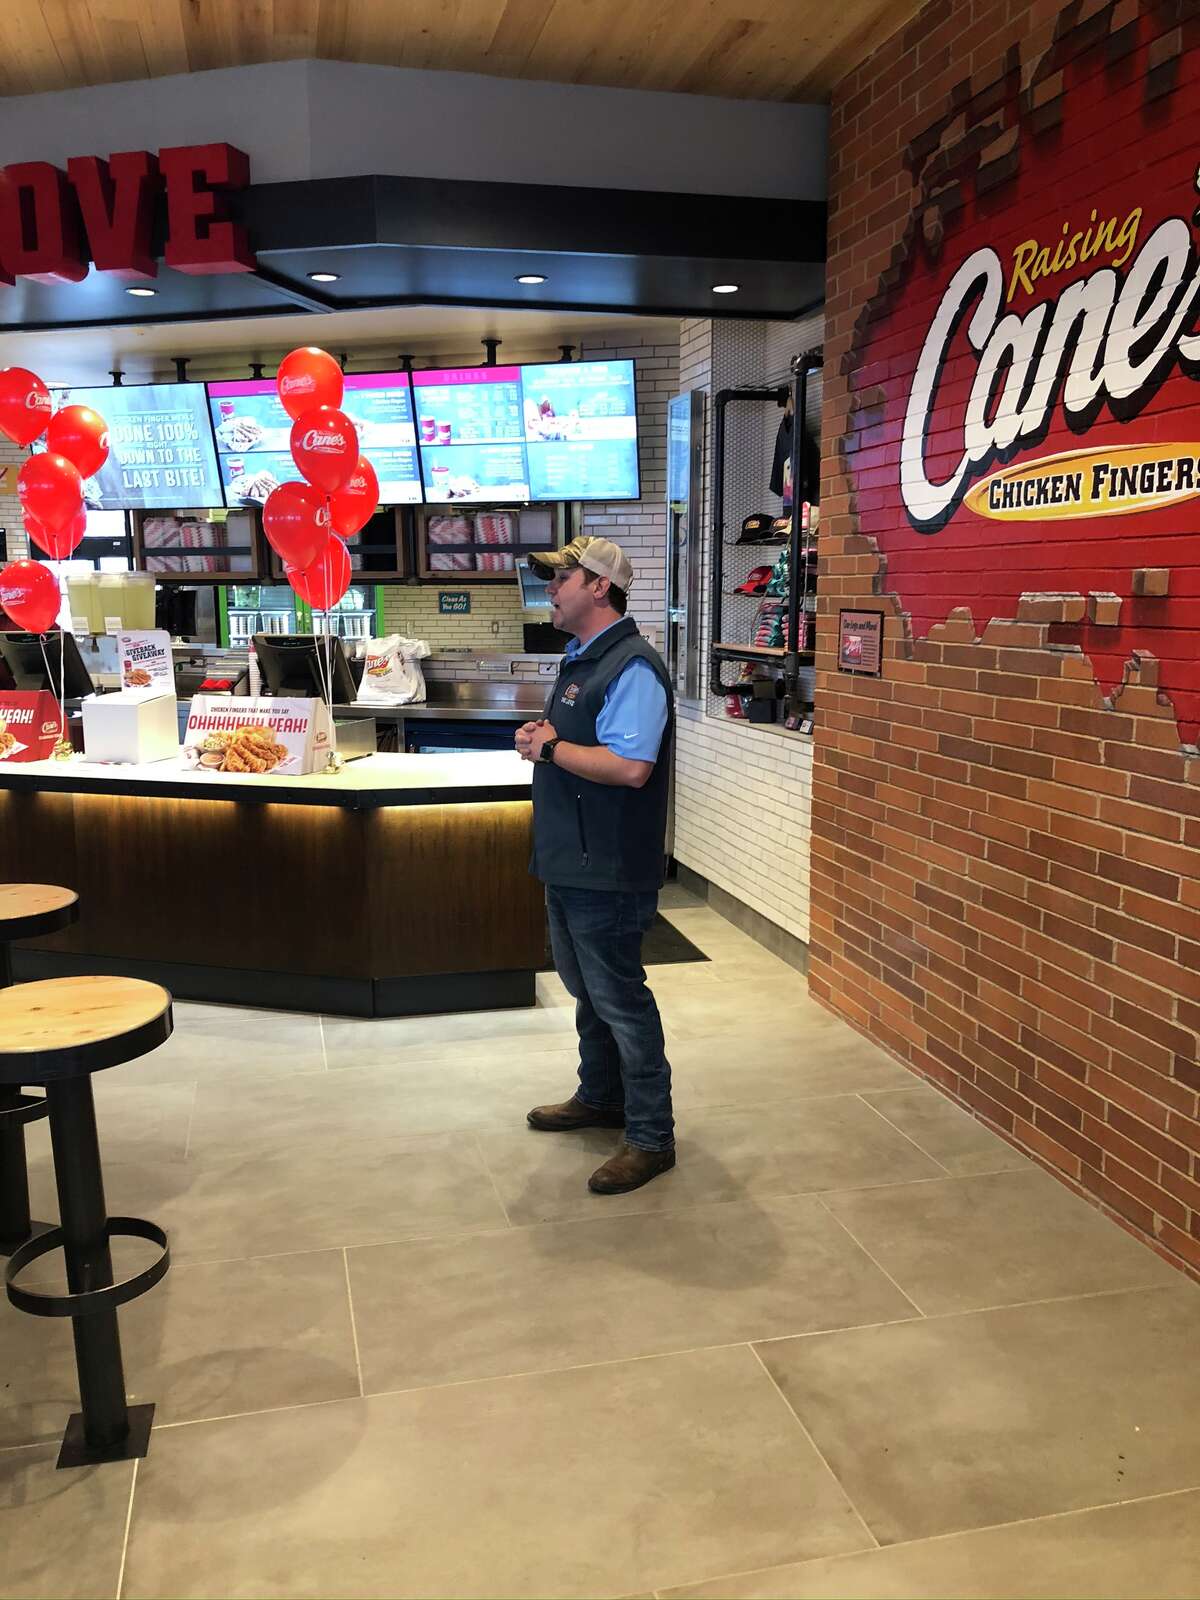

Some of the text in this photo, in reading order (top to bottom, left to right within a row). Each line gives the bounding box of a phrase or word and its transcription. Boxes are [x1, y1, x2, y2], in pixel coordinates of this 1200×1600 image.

[0, 143, 257, 285] OVE
[1007, 207, 1143, 303] Raising
[900, 218, 1200, 521] Cane
[113, 424, 153, 444] DONE
[157, 422, 199, 442] 100%
[303, 429, 345, 450] Cane's
[120, 447, 202, 465] DOWN TO THE
[123, 468, 206, 489] LAST BITE!
[989, 472, 1083, 510] CHICKEN
[126, 644, 156, 656] GIVEBACK
[131, 649, 165, 661] GIVEAWAY
[0, 708, 34, 724] YEAH!
[268, 717, 308, 733] YEAH!
